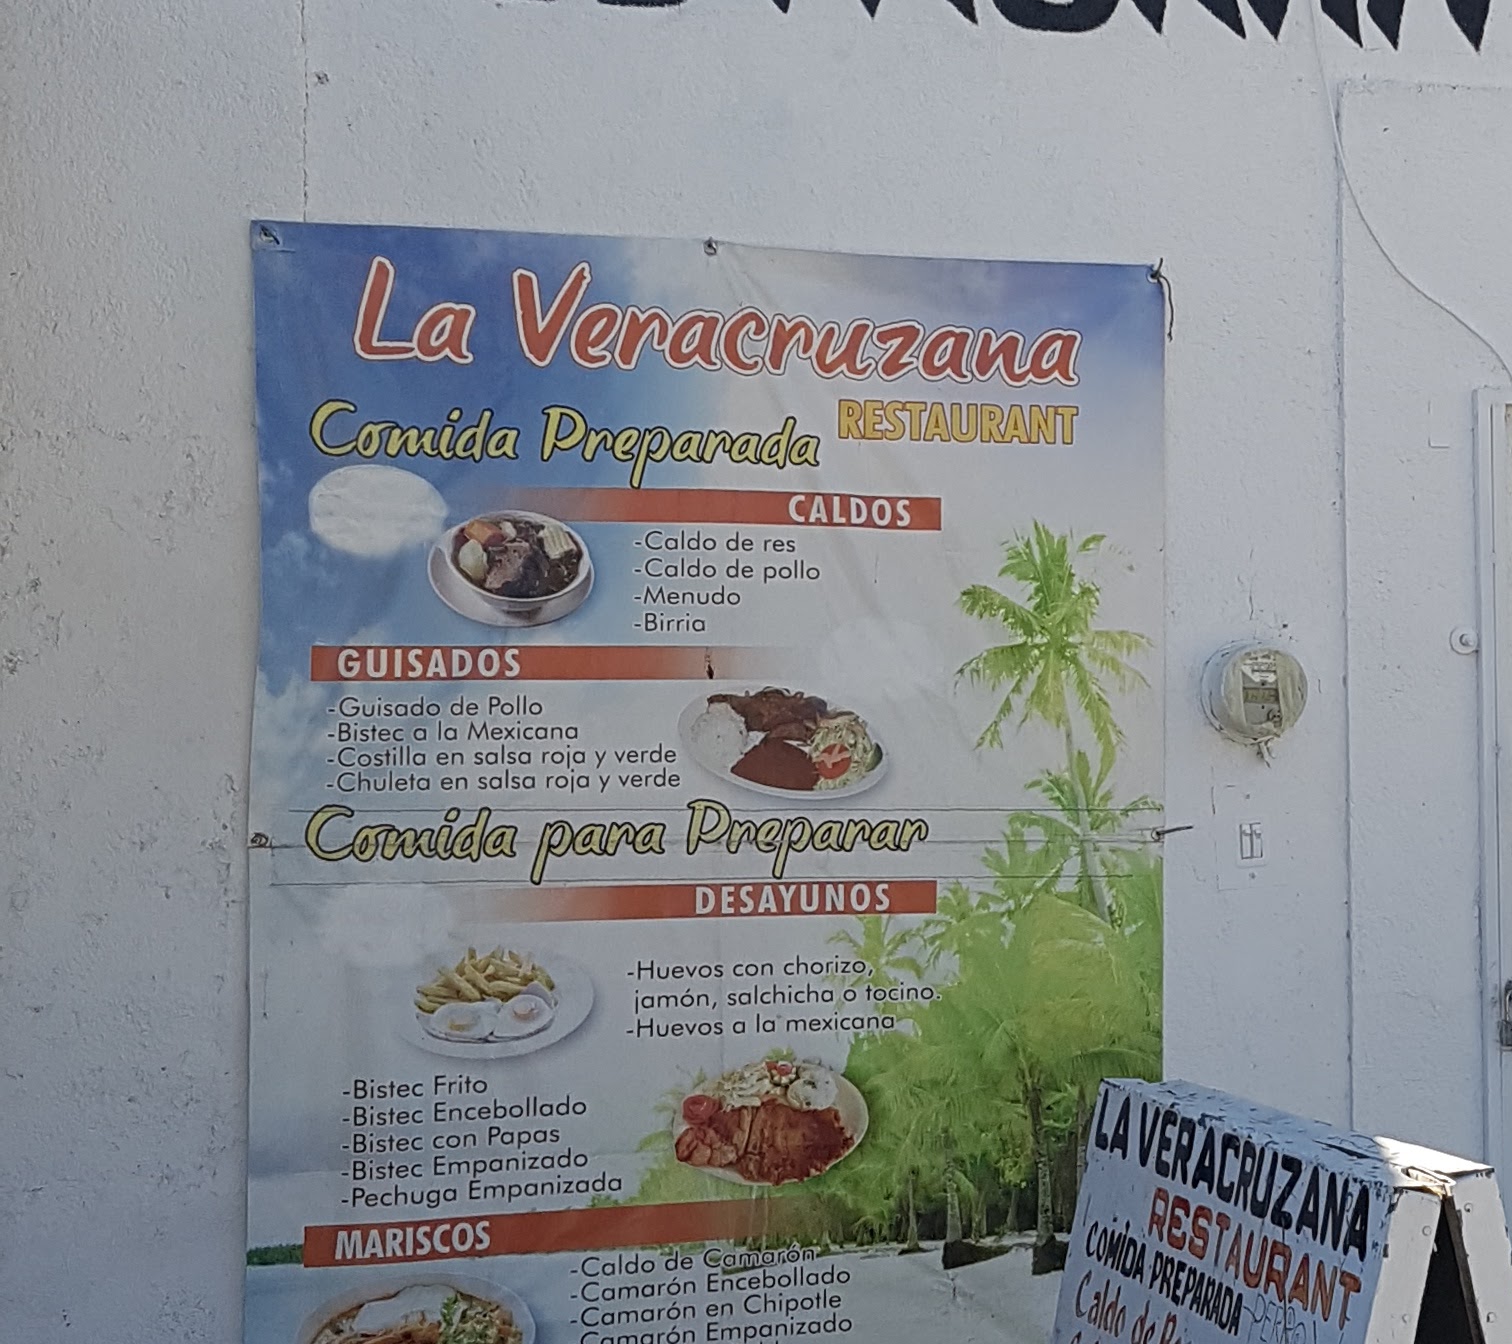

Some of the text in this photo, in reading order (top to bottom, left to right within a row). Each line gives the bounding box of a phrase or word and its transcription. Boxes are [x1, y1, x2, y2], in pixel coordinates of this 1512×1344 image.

[354, 254, 1082, 386] La Veracruzana
[309, 400, 1078, 487] Comida Preparada RESTAURANT
[788, 495, 911, 526] CALDOS
[634, 531, 796, 552] -Caldo de res
[634, 558, 820, 583] -Caldo de pollo
[634, 586, 741, 605] -Menudo
[634, 612, 706, 632] -Birria
[337, 648, 521, 678] GUISADOS
[328, 695, 543, 718] -Guisado de Pollo
[327, 721, 578, 742] -Bistec a la Mexicana
[327, 743, 677, 769] -Costilla en salsa roja y verde
[326, 769, 680, 793] -Chuleta en salsa roja y verde
[305, 800, 930, 885] Comida para Preparar
[696, 883, 890, 914] DESAYUNOS
[628, 955, 873, 980] -Huevos con chorizo,
[635, 982, 941, 1014] jamón, salchicha o tocino.
[626, 1013, 895, 1038] -Huevos a la mexicana
[342, 1075, 487, 1100] -Bistec Frito
[342, 1095, 587, 1126] -Bistec Encebollado
[342, 1126, 560, 1154] -Bistec con Papas
[341, 1148, 588, 1181] -Bistec Empanizado
[1095, 1087, 1370, 1262] LA VERACRUZANA
[341, 1172, 622, 1208] -Pechuga Empanizada
[335, 1220, 491, 1260] MARISCOS
[570, 1244, 816, 1277] -Caldo de Camarón
[1148, 1186, 1362, 1330] RESTAURANT
[570, 1266, 851, 1303] -Camarón Encebollado
[1148, 1249, 1244, 1336] PREPARADA
[570, 1289, 842, 1328] -Camarón en Chipotle
[1074, 1269, 1127, 1338] Caldo
[706, 1313, 852, 1344] Empanizado
